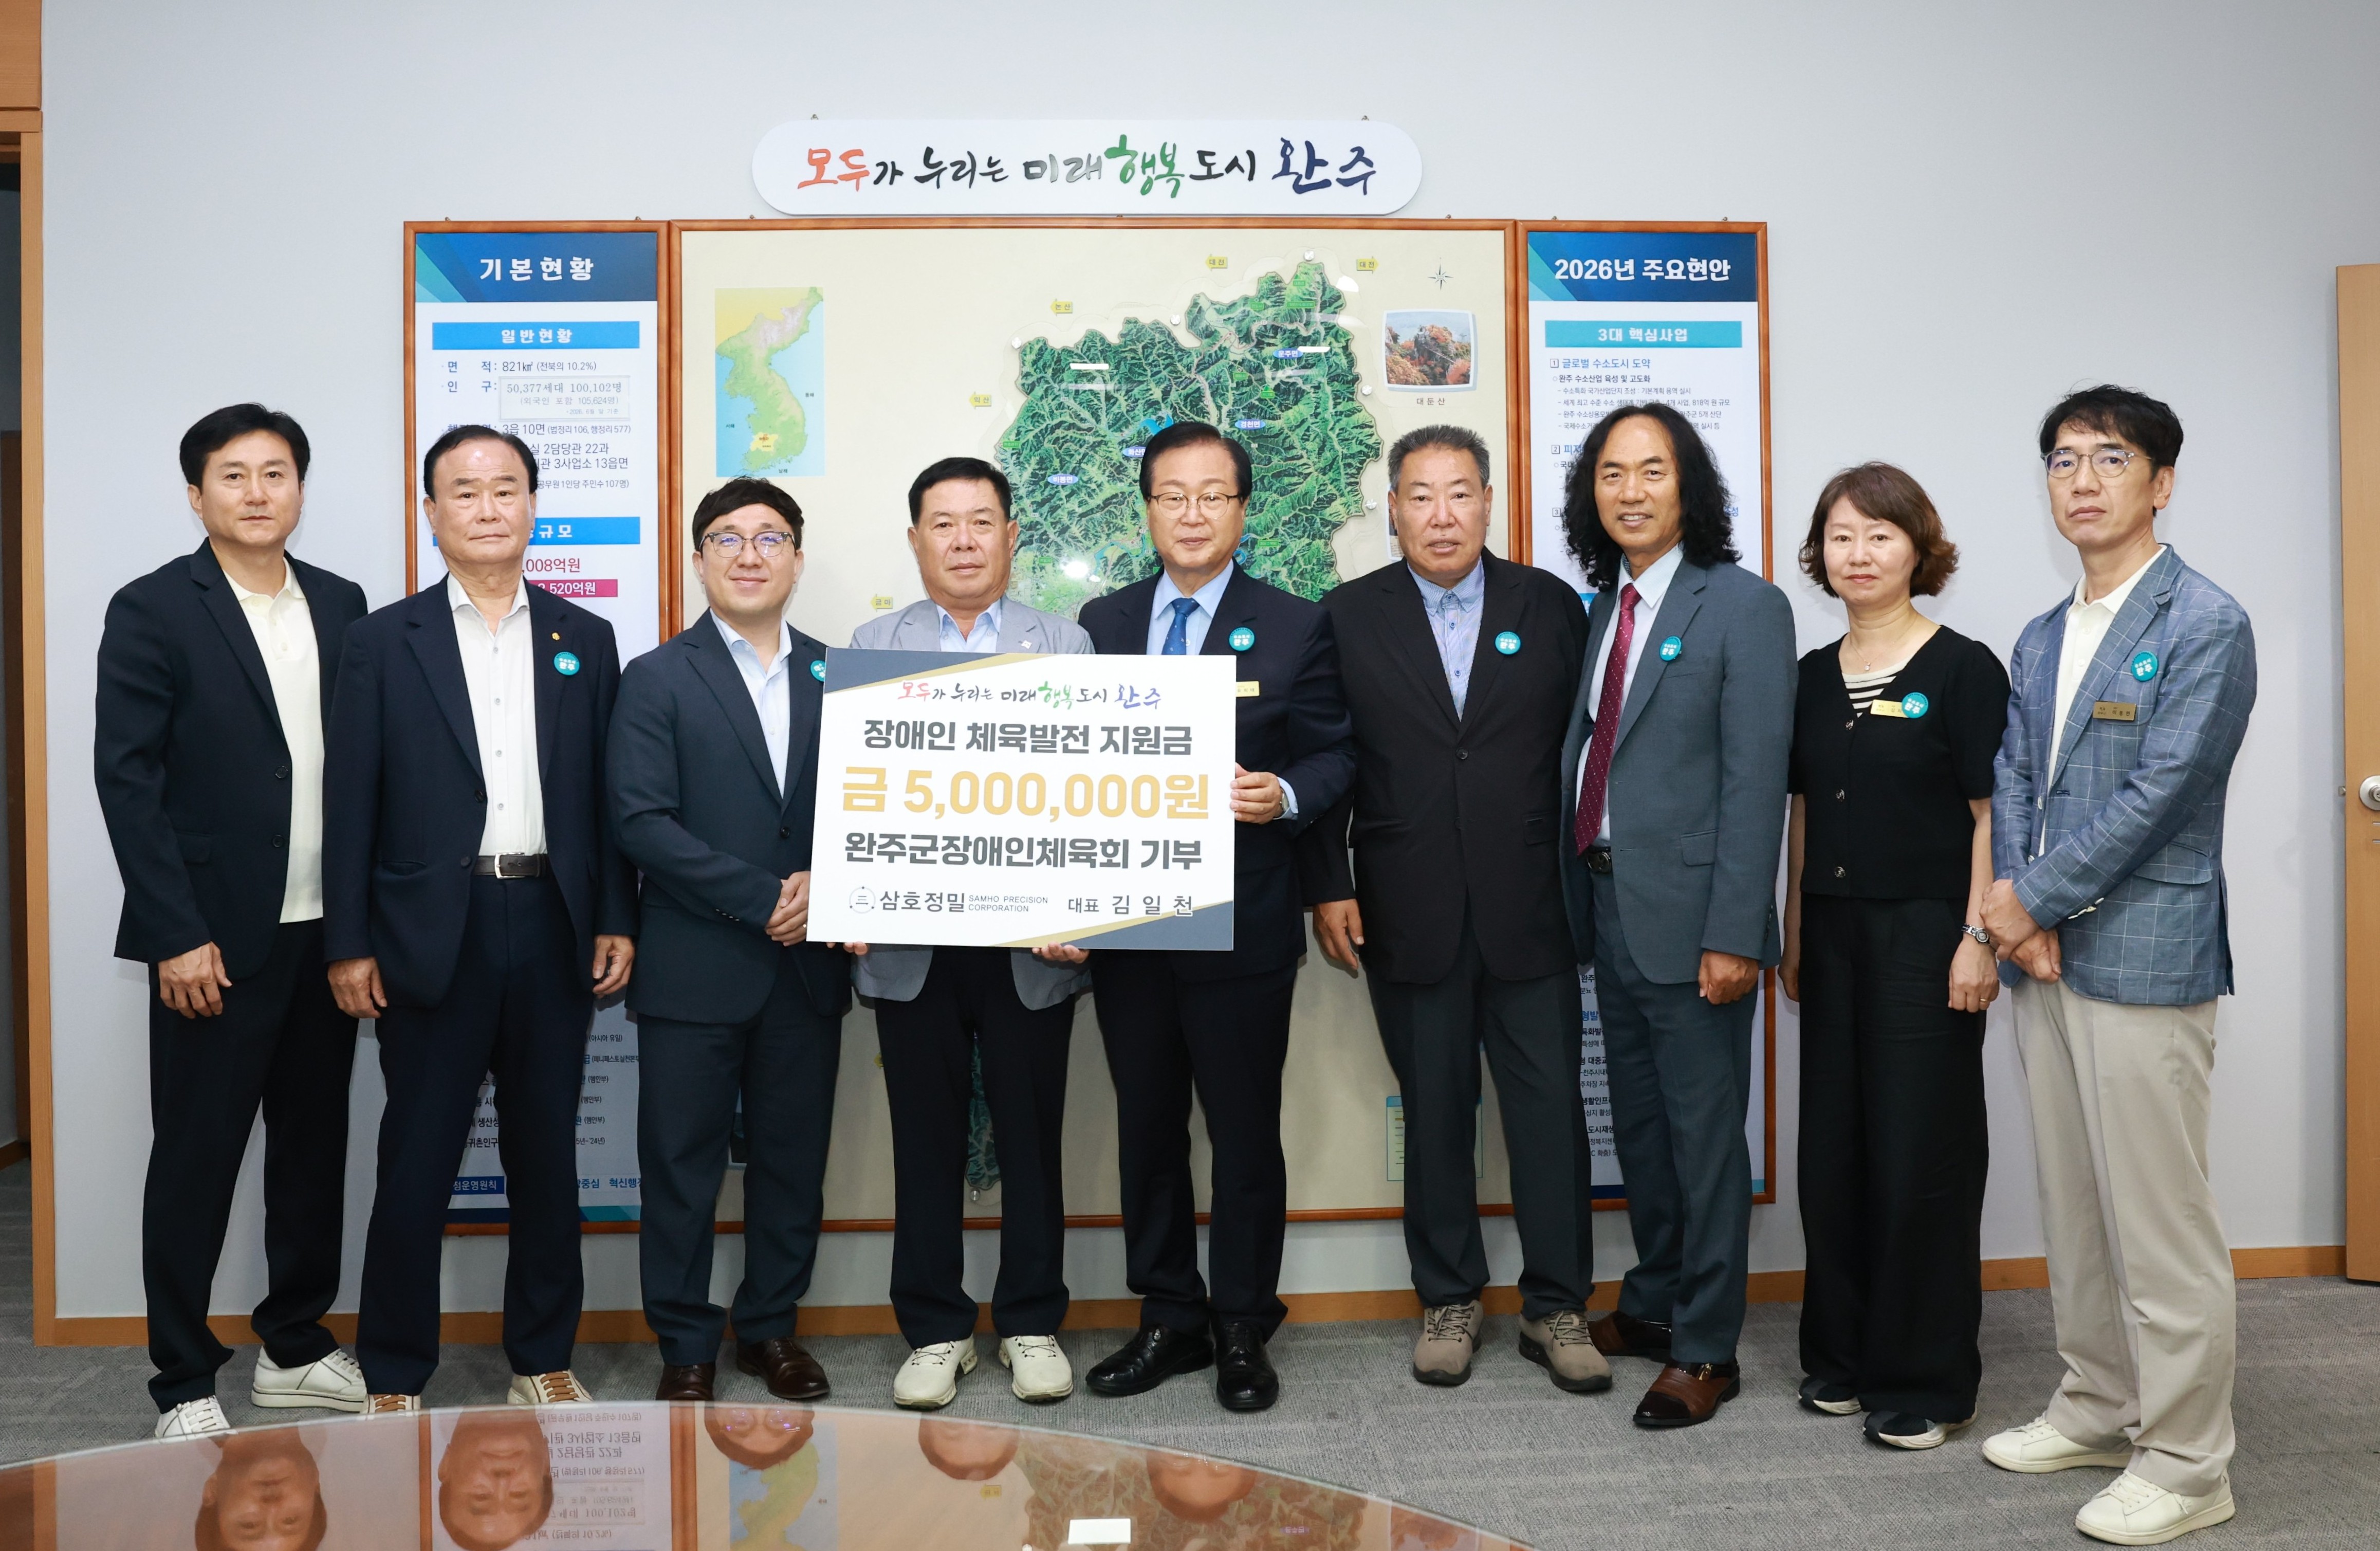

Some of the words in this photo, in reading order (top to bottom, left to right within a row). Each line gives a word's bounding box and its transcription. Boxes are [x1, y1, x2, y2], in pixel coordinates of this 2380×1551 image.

[798, 149, 903, 191] 모두가
[914, 147, 1008, 189] 누리는
[1272, 137, 1376, 195] 완주
[479, 256, 594, 282] 기본현황
[1554, 258, 1635, 282] 2026년
[1641, 257, 1732, 282] 주요현안
[501, 328, 573, 344] 일반현황
[1597, 327, 1623, 343] 3대
[1628, 327, 1689, 342] 핵심사업
[448, 361, 457, 372] 면
[537, 362, 563, 371] (전북의
[568, 361, 596, 370] 10.2%)
[1561, 357, 1590, 370] 글로벌
[1593, 359, 1628, 369] 수소도시
[1632, 359, 1650, 368] 도약
[1604, 374, 1618, 382] 육성
[448, 381, 457, 392] 인
[507, 383, 563, 393] 50,377세대
[571, 382, 621, 393] 100,102명
[1562, 387, 1587, 395] 수소특화
[1587, 387, 1623, 395] 국가산업단지
[1666, 387, 1678, 395] 용역
[577, 396, 618, 406] 105,624명)
[523, 424, 545, 435] 10면
[544, 443, 581, 454] 2담당관
[585, 443, 609, 454] 22과
[555, 459, 592, 469] 3사업소
[596, 458, 628, 468] 13읍면
[896, 680, 946, 701] 모두가
[951, 683, 992, 702] 누리는
[1115, 684, 1161, 709] 완주
[863, 718, 957, 752] 장애인
[966, 720, 1091, 755] 체육발전
[1099, 723, 1193, 757] 지원금
[841, 765, 889, 813] 금
[905, 770, 1208, 822] 5,000,000원
[845, 833, 1129, 868] 완주군장애인체육회
[1141, 840, 1202, 869] 기부
[880, 891, 964, 913] 삼호정밀
[1068, 897, 1099, 913] 대표
